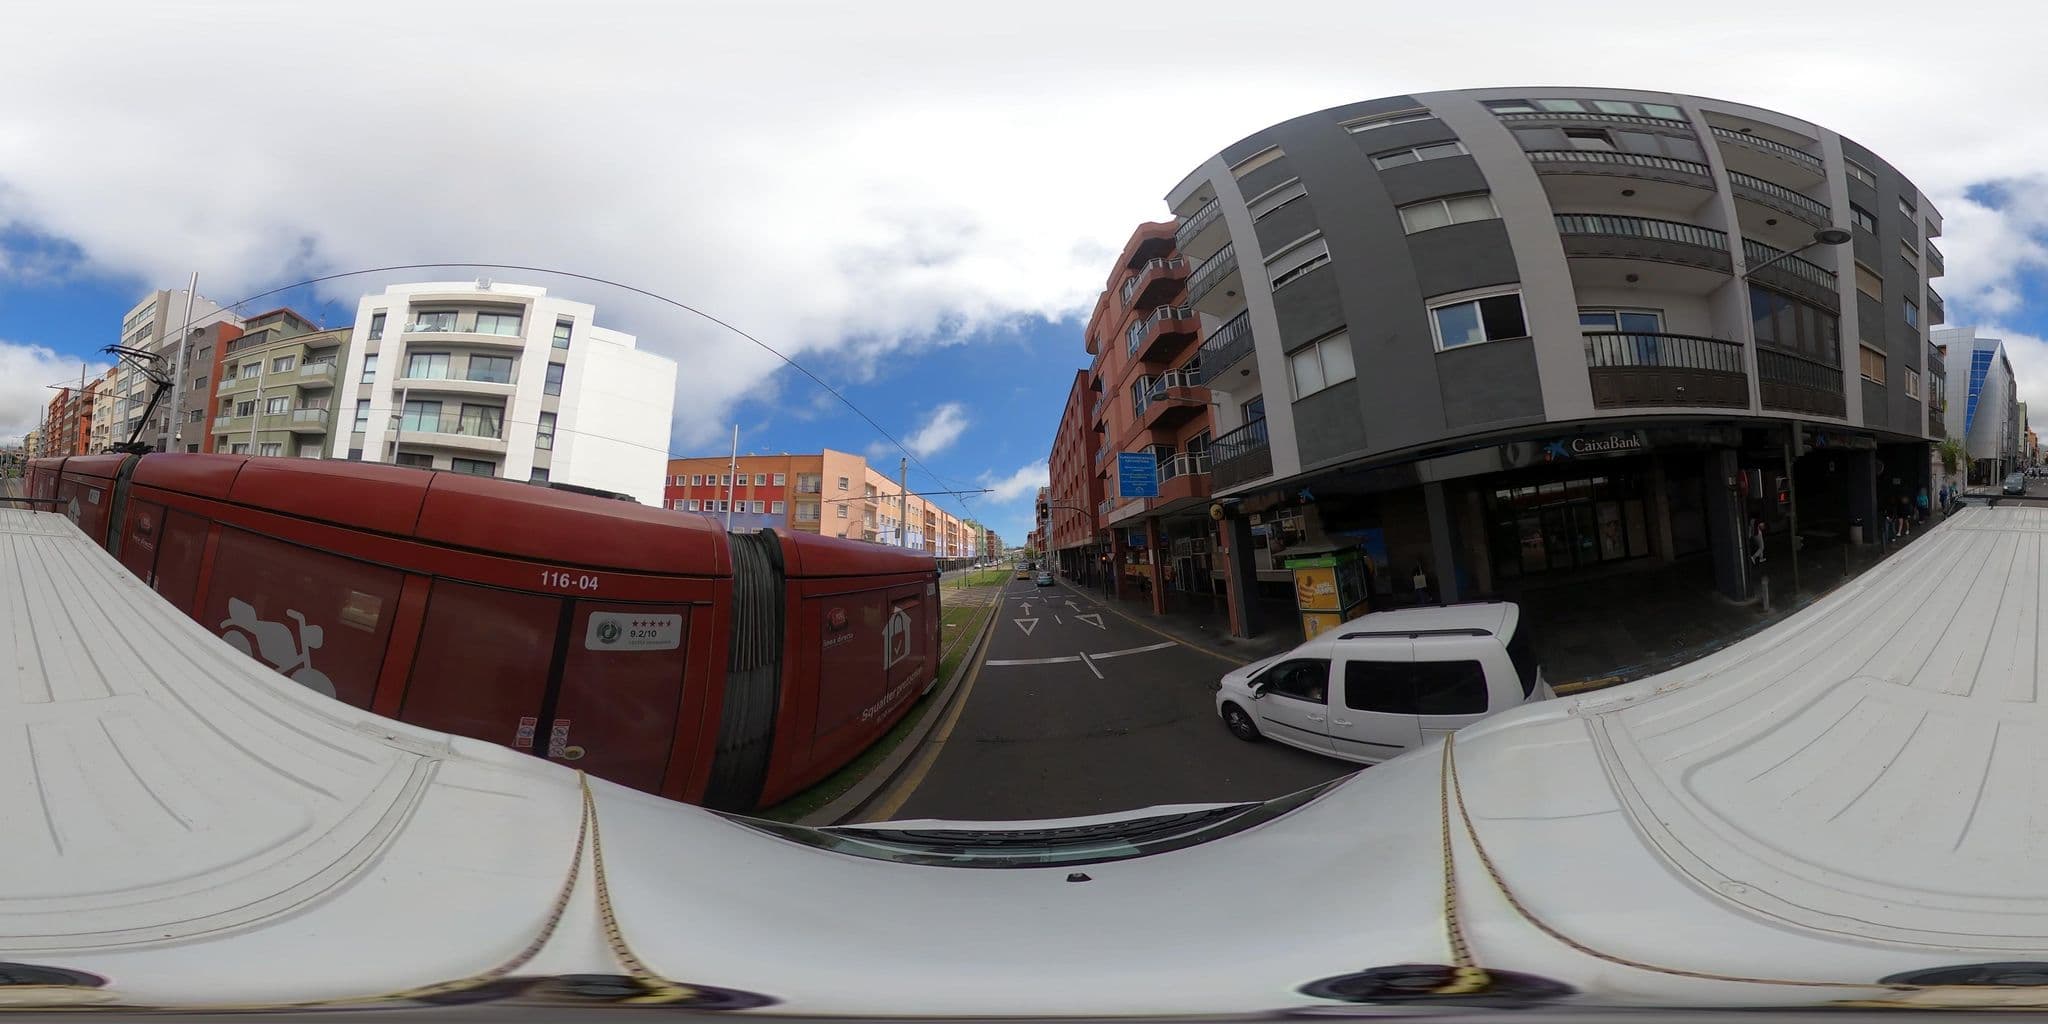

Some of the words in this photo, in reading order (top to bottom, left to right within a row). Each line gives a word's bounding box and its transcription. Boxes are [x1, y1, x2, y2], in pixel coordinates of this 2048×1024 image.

[1572, 434, 1641, 452] CaixaBank
[541, 570, 598, 590] 116-04
[630, 630, 657, 638] 9.2/10
